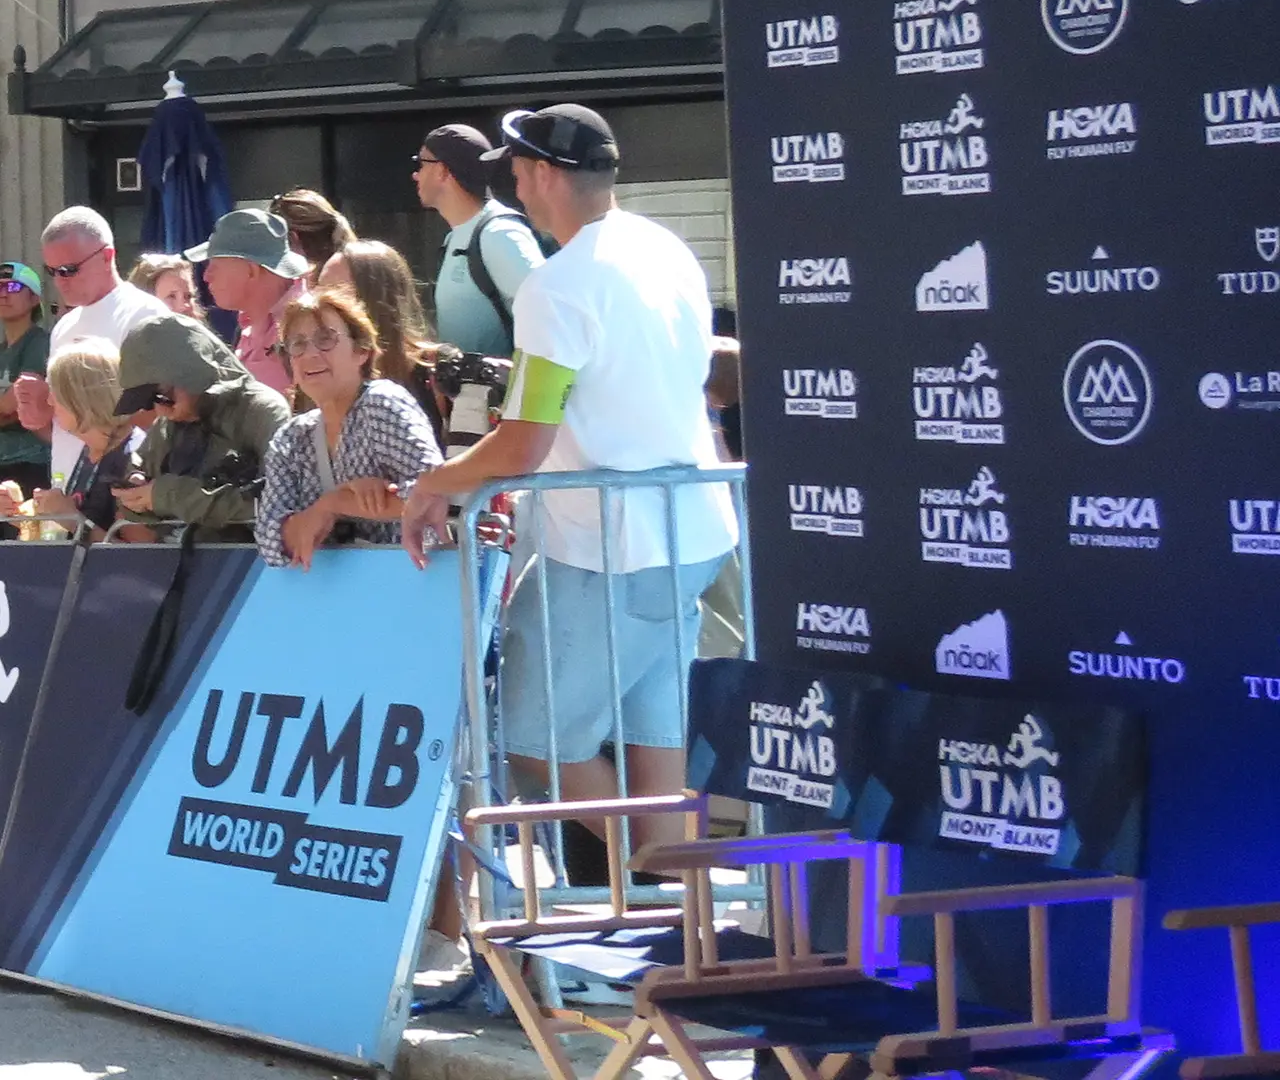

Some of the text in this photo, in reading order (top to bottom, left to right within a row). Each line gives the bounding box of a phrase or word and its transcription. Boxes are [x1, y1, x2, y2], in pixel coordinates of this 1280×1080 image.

[766, 15, 839, 49] UTMB
[893, 12, 981, 52] UTMB
[899, 120, 943, 139] HOKA
[1047, 102, 1137, 141] HOKA
[771, 132, 844, 163] UTMB
[899, 136, 988, 173] UTMB
[1068, 142, 1114, 158] HUMAN
[778, 257, 851, 287] HOKA
[1046, 266, 1161, 294] SUUNTO
[924, 280, 980, 304] näak
[783, 370, 856, 396] UTMB
[913, 367, 956, 383] HOKA
[1235, 372, 1263, 392] La
[913, 386, 1002, 418] UTMB
[788, 485, 863, 514] UTMB
[919, 488, 964, 505] HOKA
[920, 508, 1009, 542] UTMB
[1069, 495, 1161, 529] HOKA
[1229, 499, 1280, 532] UT
[1090, 534, 1138, 548] HUMAN
[797, 603, 871, 637] HOKA
[944, 644, 1002, 672] näak
[1068, 650, 1186, 684] SUUNTO
[750, 702, 793, 726] HOKA
[750, 724, 837, 777] UTMB
[939, 738, 1002, 767] HOKA
[941, 765, 1065, 820] UTMB
[183, 810, 390, 888] WORLD SERIES
